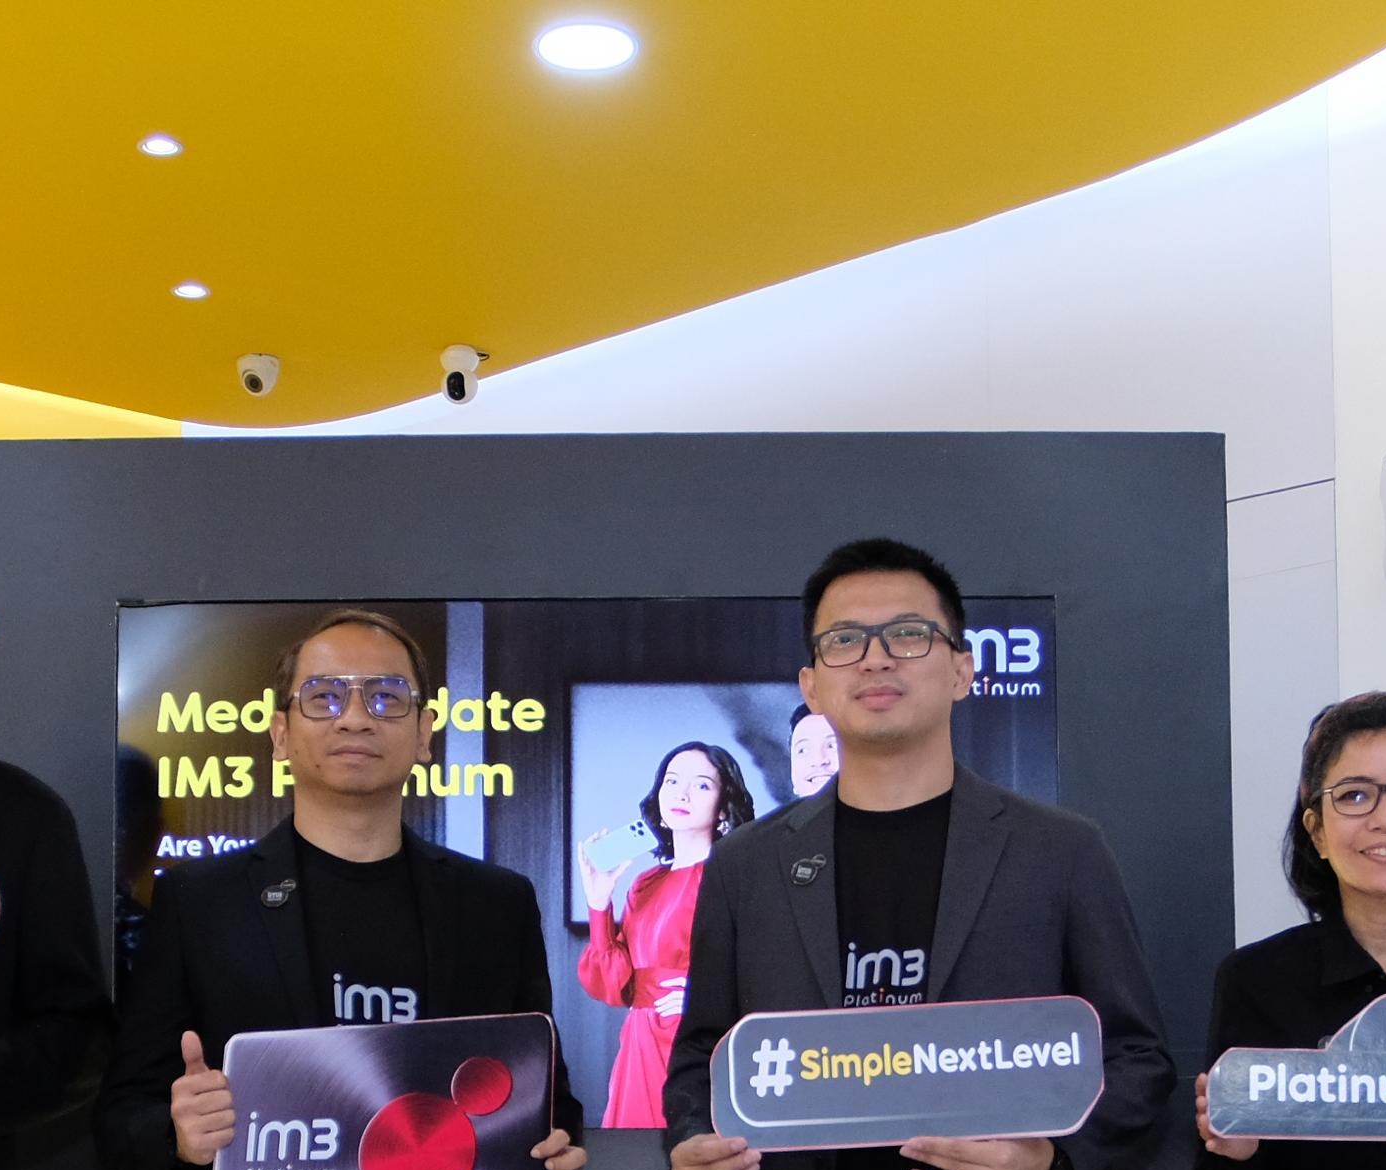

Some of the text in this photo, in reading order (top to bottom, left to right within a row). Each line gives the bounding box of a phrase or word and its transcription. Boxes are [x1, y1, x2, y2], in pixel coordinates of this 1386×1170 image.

[963, 628, 1040, 673] m3
[966, 675, 1041, 696] tinum
[157, 687, 546, 733] Med date
[158, 756, 254, 799] IM3
[156, 835, 203, 857] Are
[845, 942, 925, 989] im3
[333, 973, 417, 1023] im3
[749, 1031, 1081, 1098] #SimpleNextLevel
[245, 1111, 339, 1162] im3
